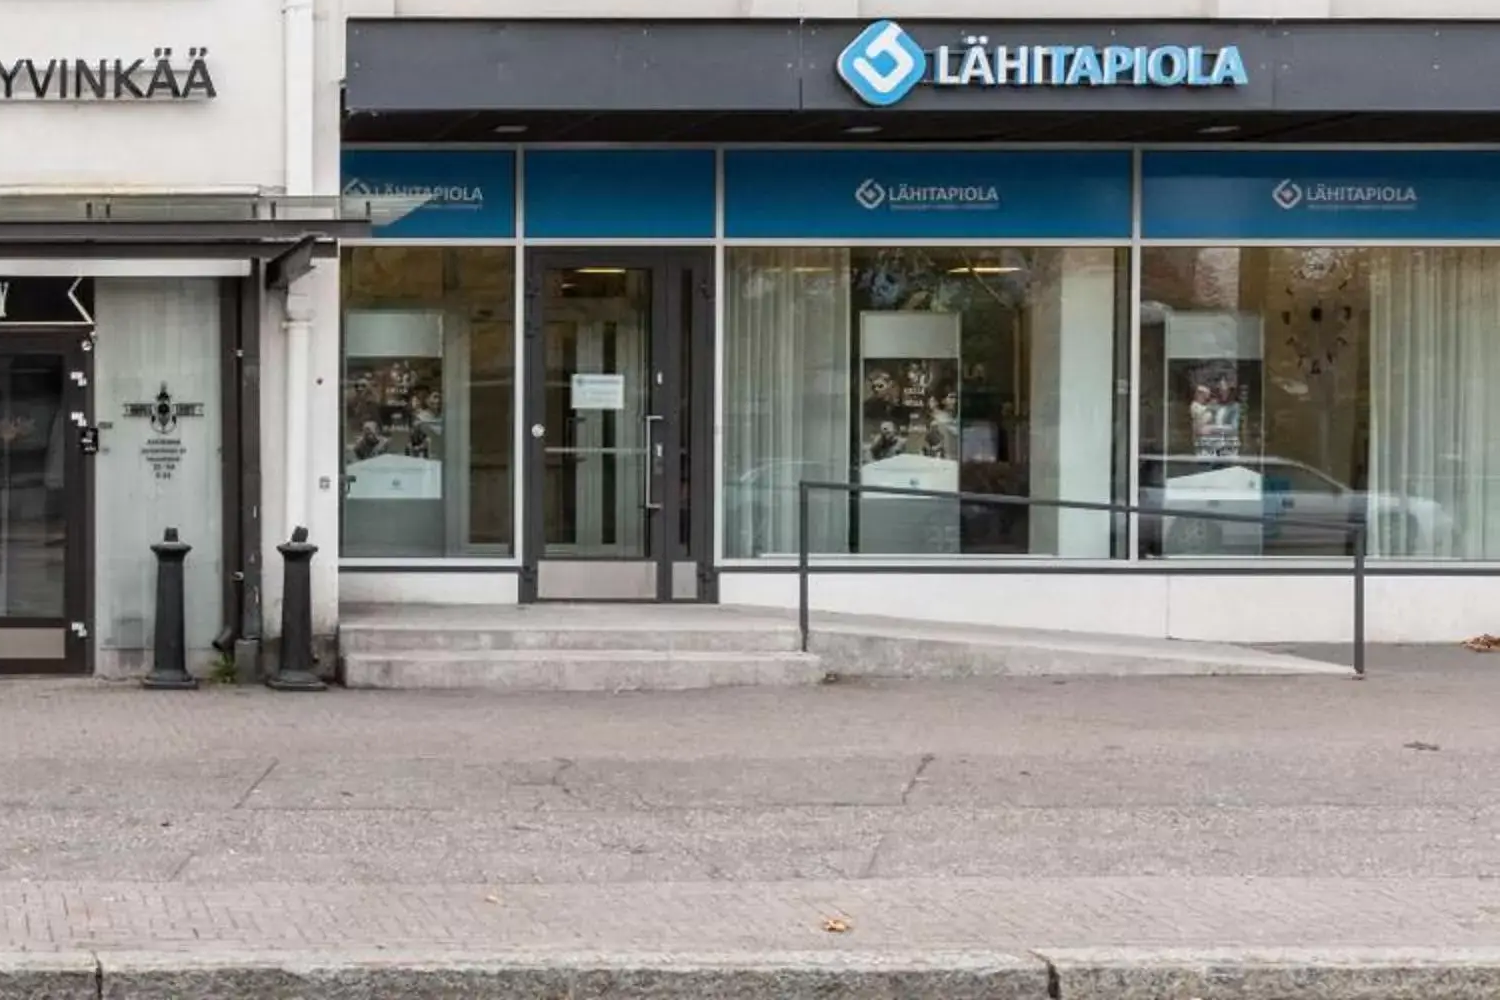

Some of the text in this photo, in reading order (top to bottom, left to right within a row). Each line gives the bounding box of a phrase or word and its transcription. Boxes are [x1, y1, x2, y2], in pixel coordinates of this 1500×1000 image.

[934, 34, 1249, 86] LÄHITAPIOLA
[888, 183, 1000, 201] LÄHITAPIOLA
[1306, 183, 1418, 201] LÄHITAPIOLA
